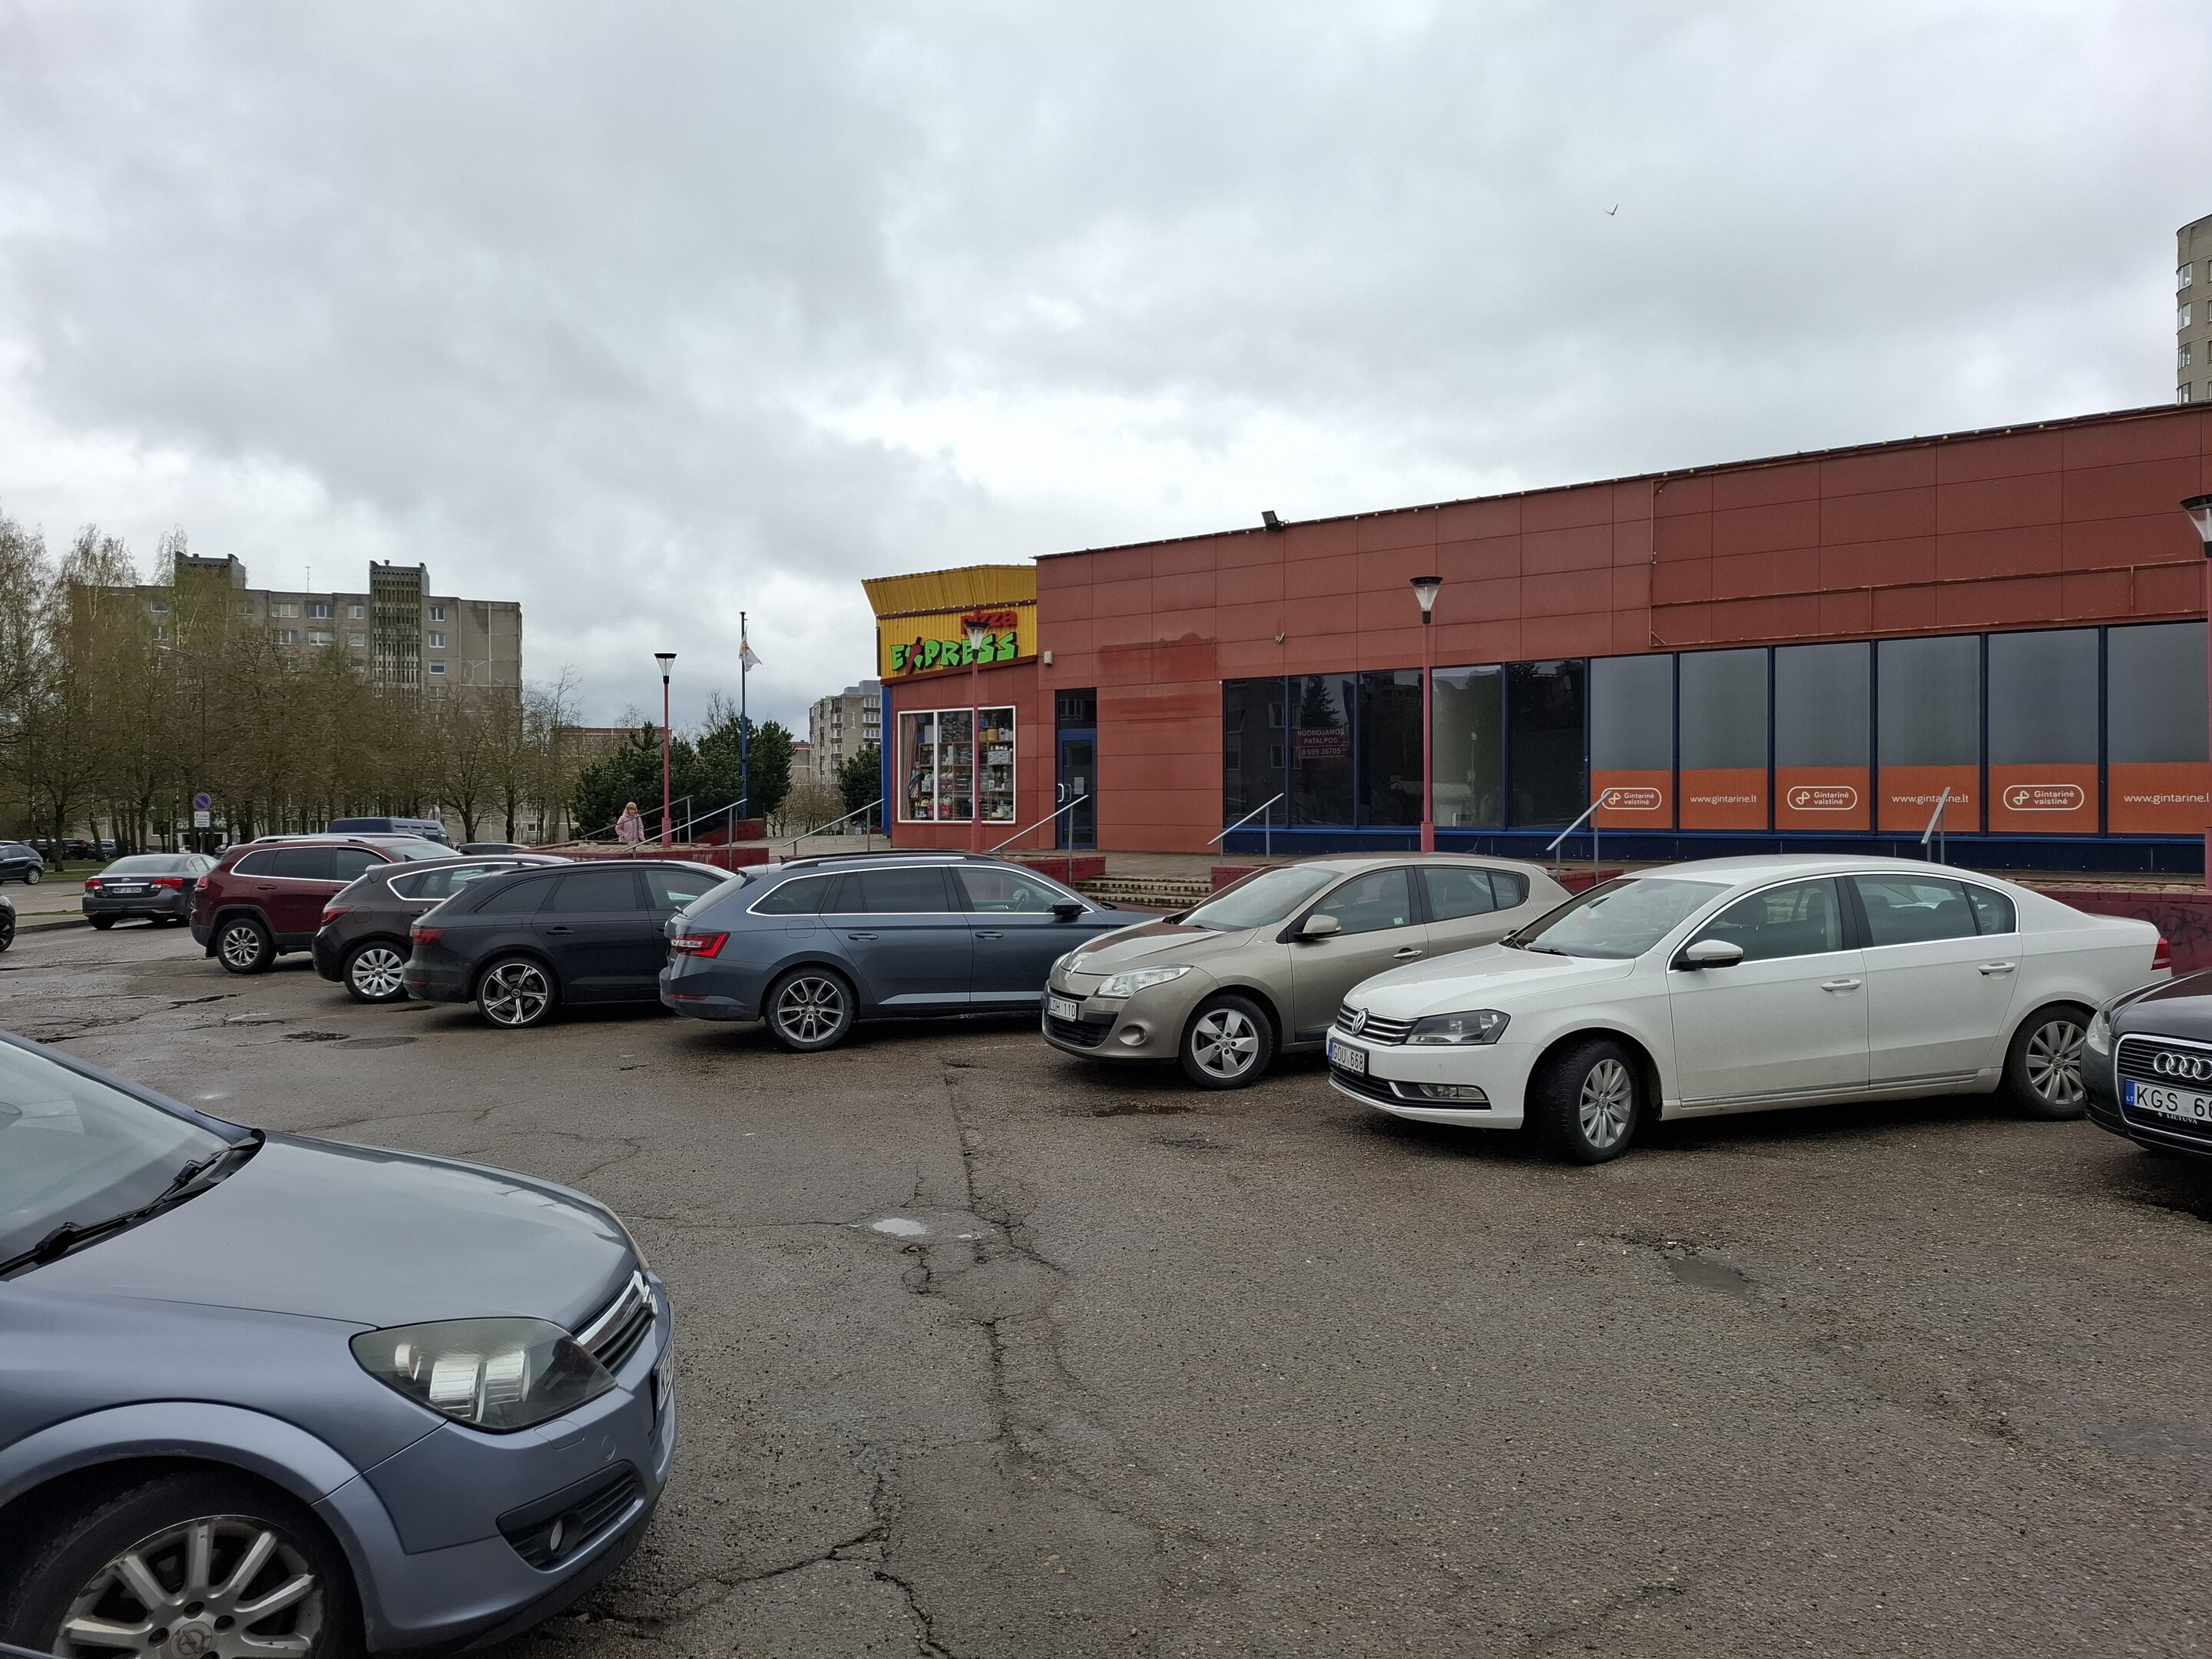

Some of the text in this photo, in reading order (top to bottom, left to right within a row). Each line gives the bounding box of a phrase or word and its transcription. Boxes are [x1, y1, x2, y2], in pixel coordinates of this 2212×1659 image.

[1690, 794, 1757, 805] www.gintarine.lt
[1892, 793, 1969, 804] www.gintane.lt
[2124, 793, 2210, 804] www.gintarine.l
[1065, 1002, 1075, 1017] 110
[1350, 1051, 1363, 1071] 668
[2137, 1085, 2178, 1112] KGS
[2167, 1113, 2198, 1124] LIETUVA
